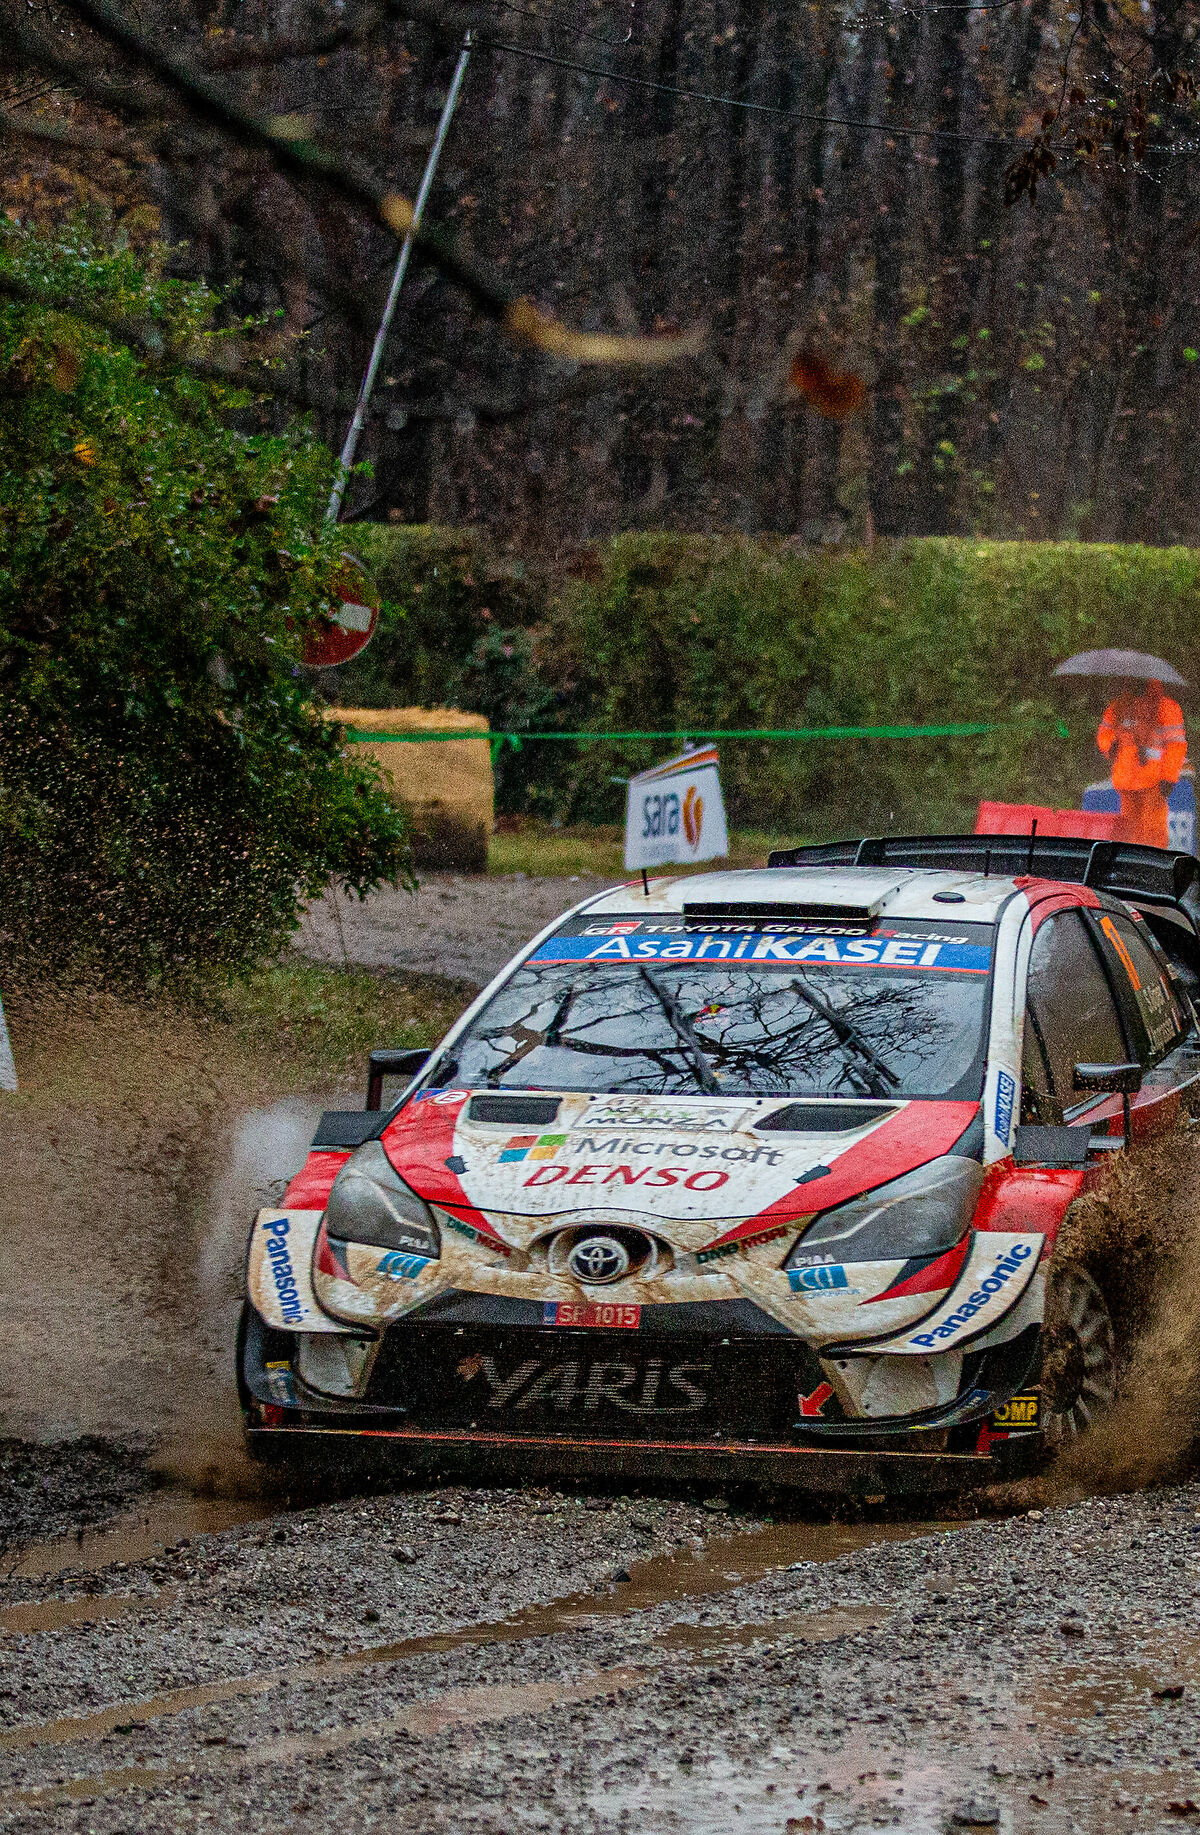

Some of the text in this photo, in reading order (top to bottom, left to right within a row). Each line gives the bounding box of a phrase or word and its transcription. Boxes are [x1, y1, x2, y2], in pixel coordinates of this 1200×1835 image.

[642, 793, 680, 838] sara
[645, 924, 756, 934] TOYOTA
[761, 924, 866, 936] GAZOO
[872, 928, 970, 944] Racing
[585, 935, 943, 966] AsahiKASEI
[585, 1117, 727, 1127] MONZA
[574, 1136, 784, 1167] Microsoft
[523, 1165, 730, 1191] DENSO
[263, 1217, 310, 1325] Panasonic
[909, 1244, 1033, 1348] Panasonic
[558, 1304, 637, 1325] SP 1015
[481, 1355, 713, 1415] YARIS
[994, 1401, 1039, 1421] OMP
